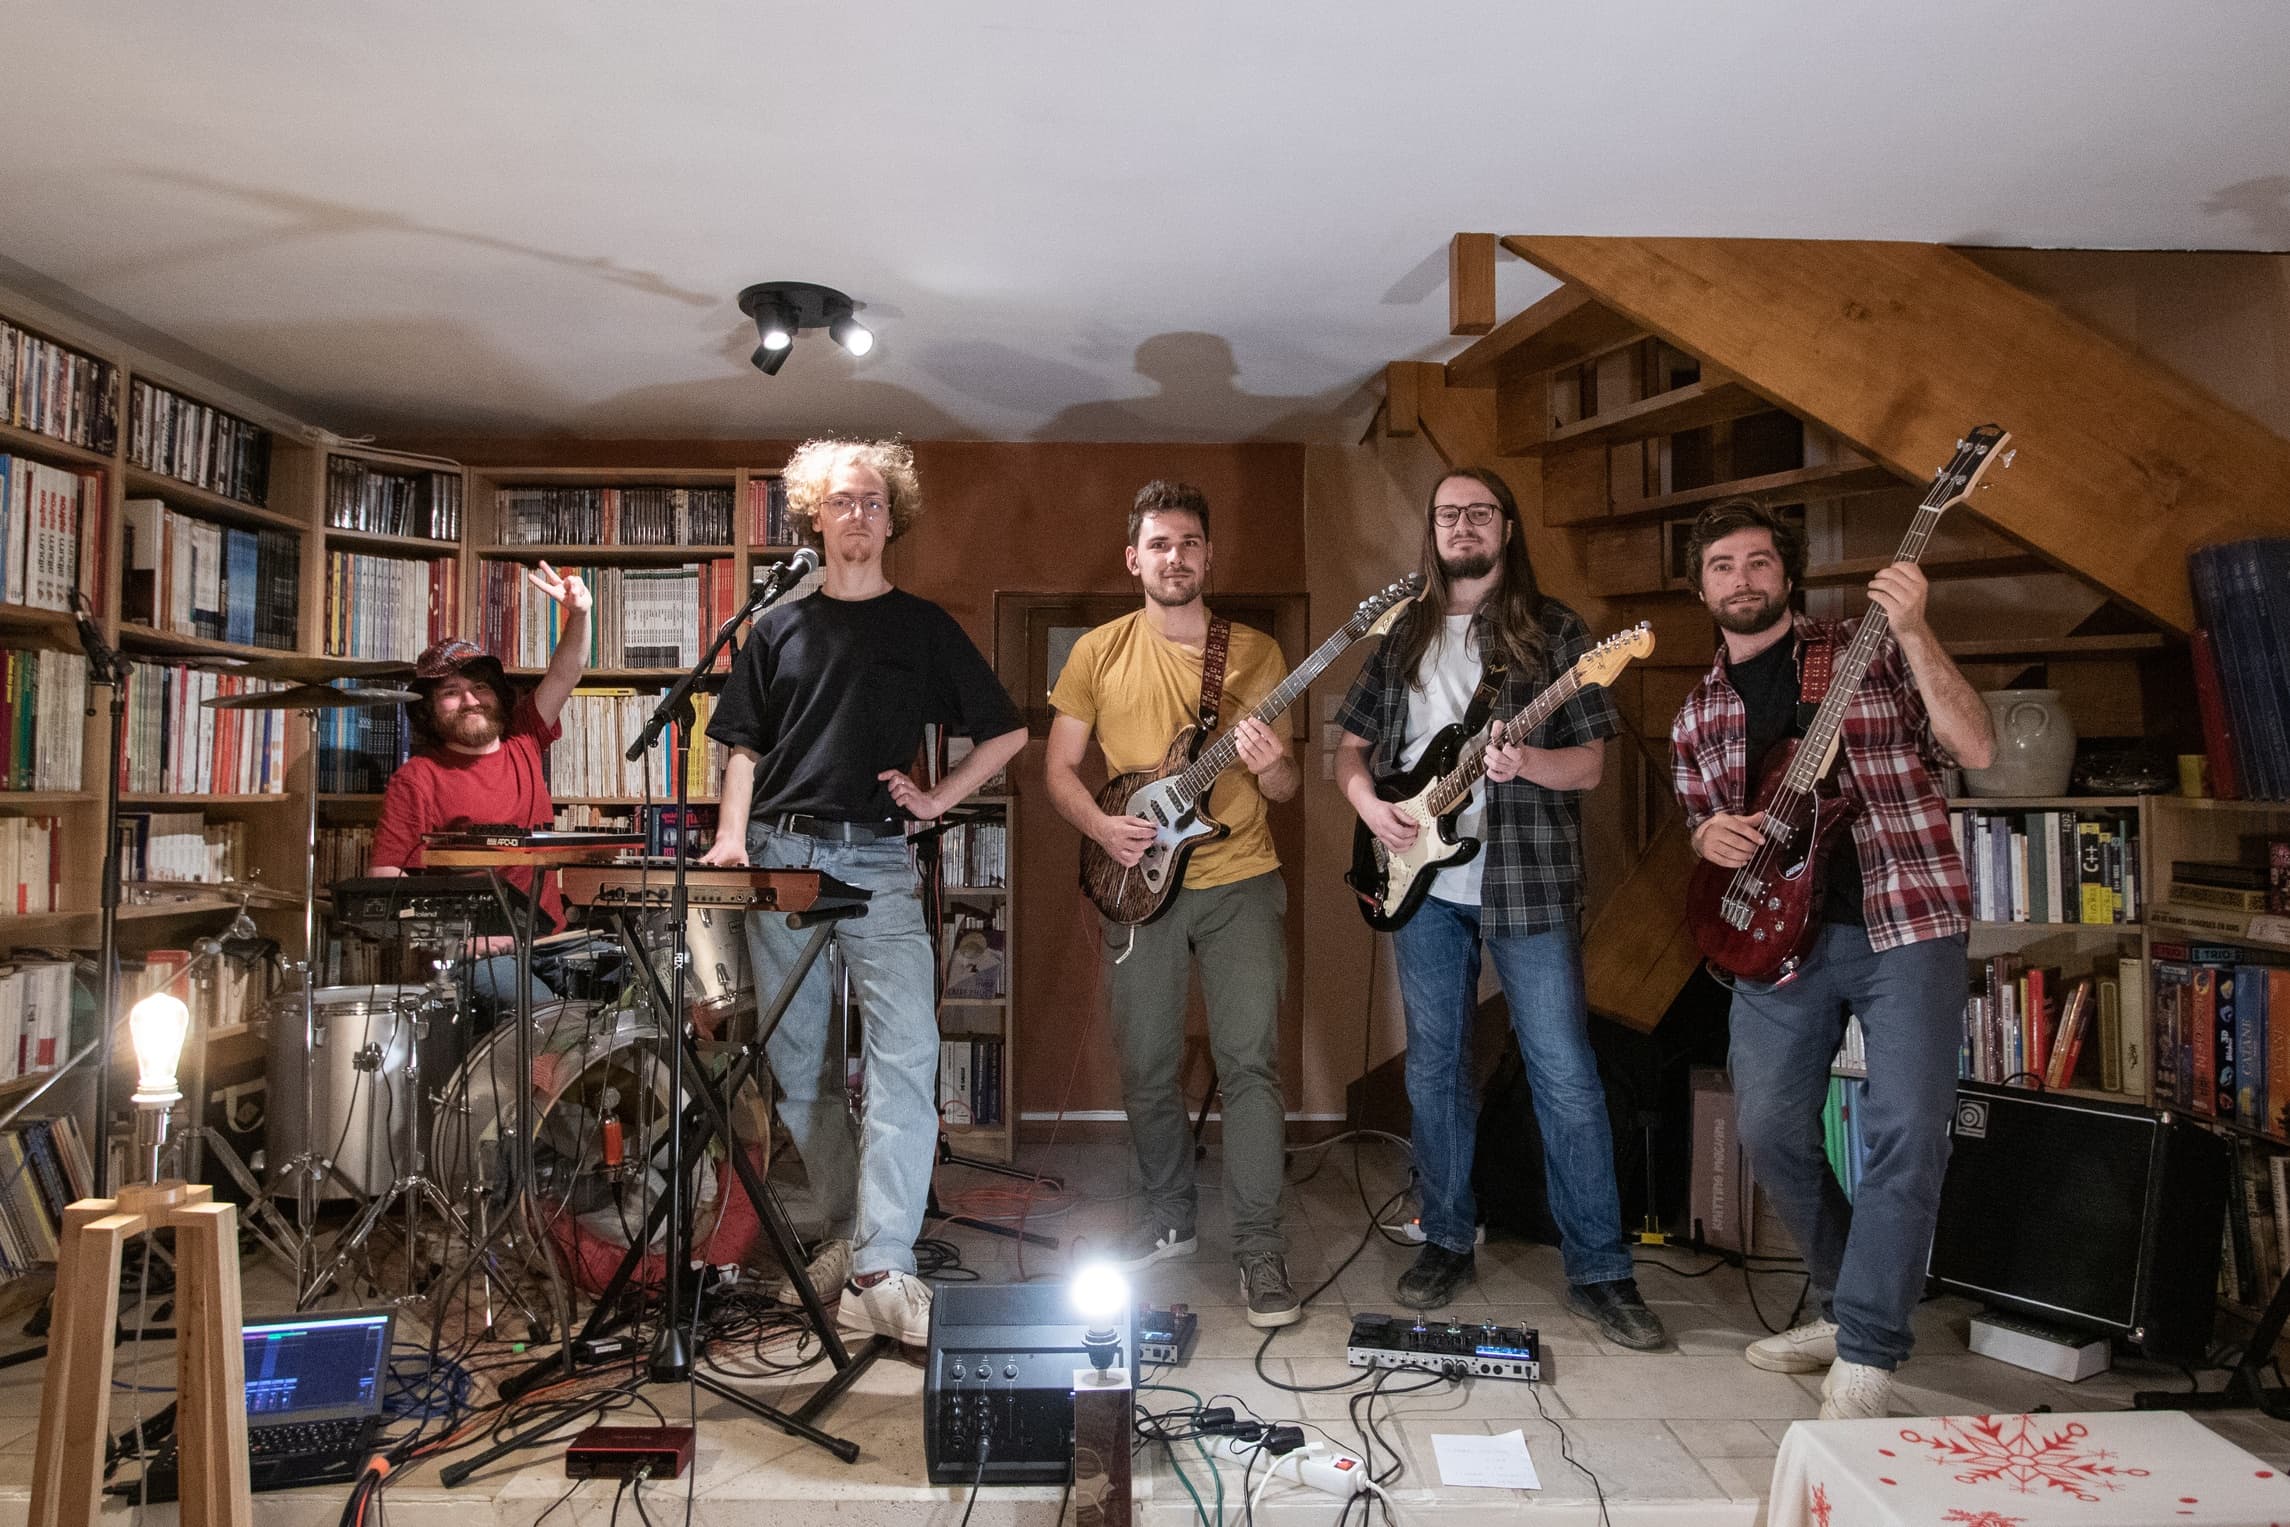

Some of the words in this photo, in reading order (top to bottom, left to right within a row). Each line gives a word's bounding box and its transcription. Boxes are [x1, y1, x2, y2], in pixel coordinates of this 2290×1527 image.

[2083, 845, 2099, 873] C++
[2205, 949, 2231, 959] TRIO
[2239, 1017, 2253, 1077] CATANE
